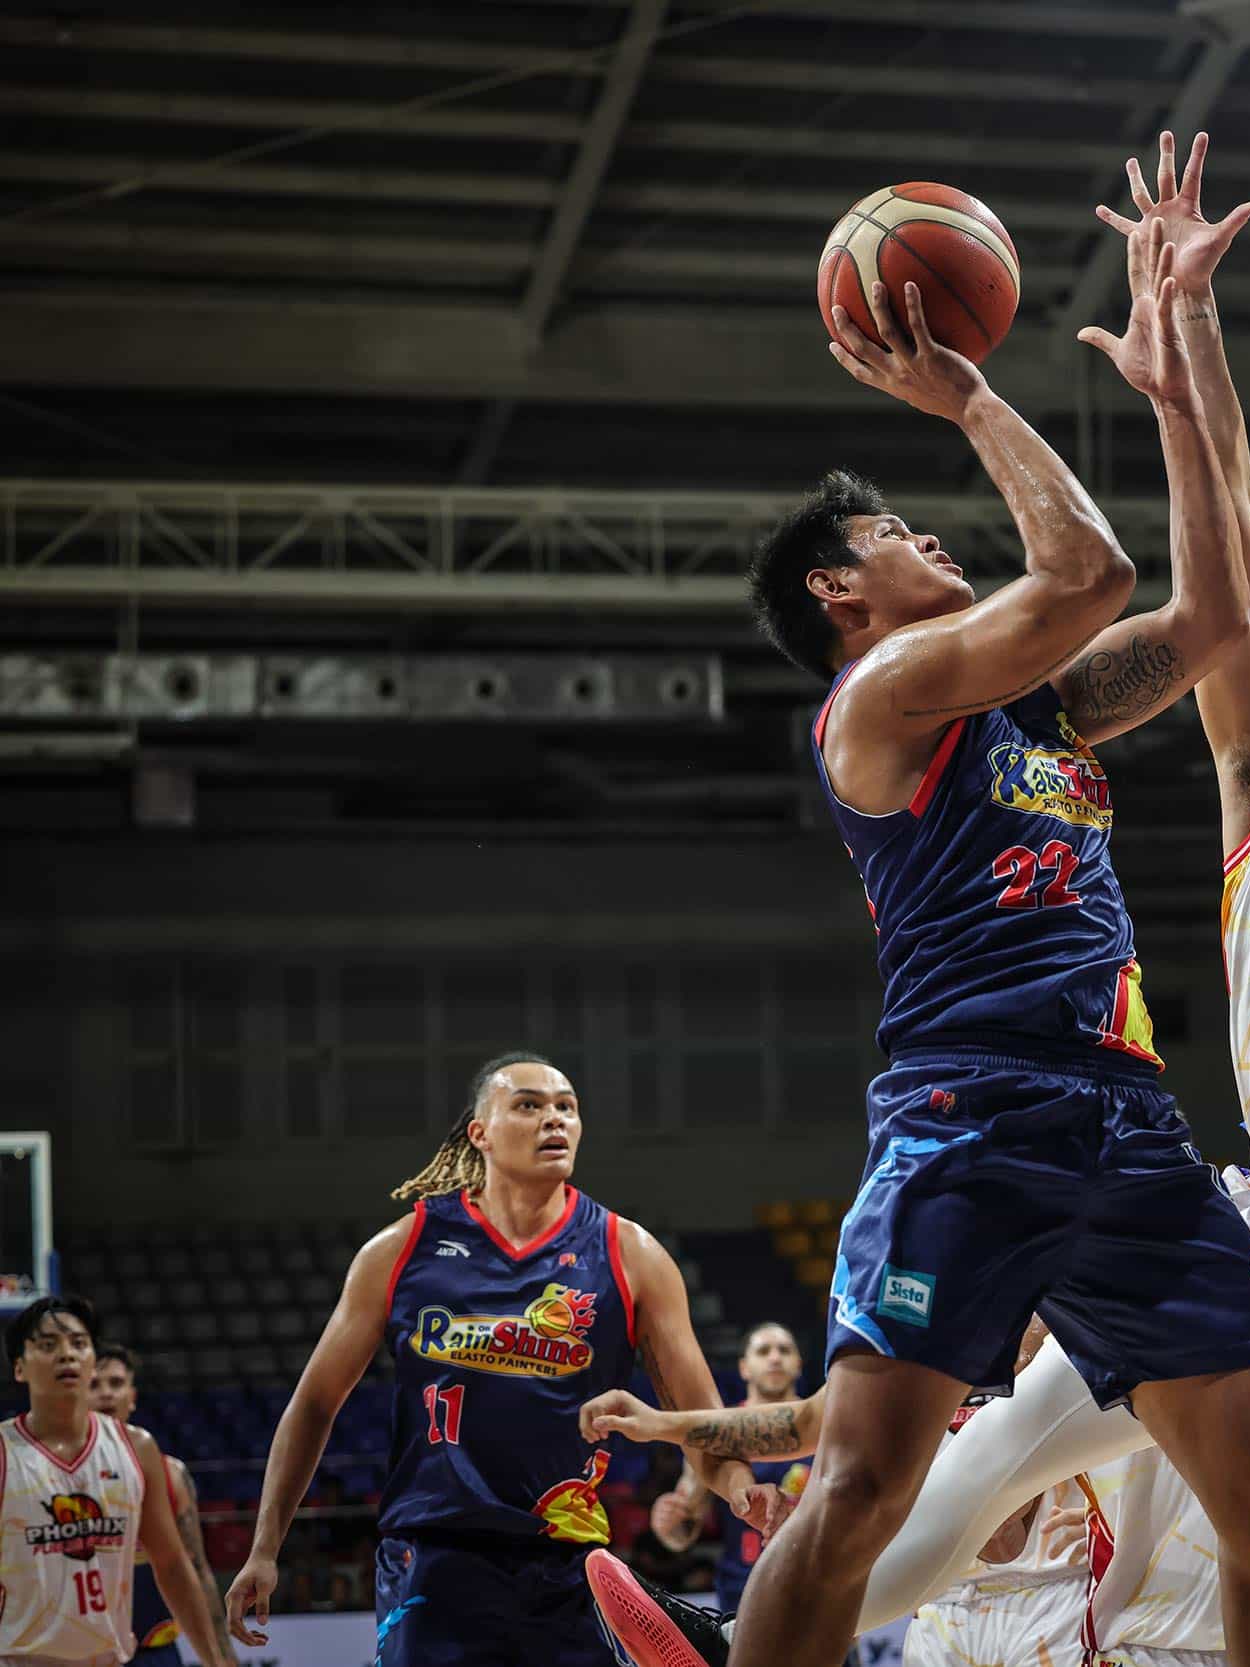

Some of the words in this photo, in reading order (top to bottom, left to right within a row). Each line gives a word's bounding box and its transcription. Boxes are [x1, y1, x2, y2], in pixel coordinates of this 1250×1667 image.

[992, 840, 1083, 909] 22
[890, 1280, 924, 1304] Sista
[420, 1308, 490, 1354] Rain
[487, 1320, 590, 1366] Shine
[450, 1351, 496, 1364] ELASTO
[497, 1356, 559, 1376] PAINTERS
[423, 1384, 465, 1445] 11
[73, 1569, 107, 1615] 19
